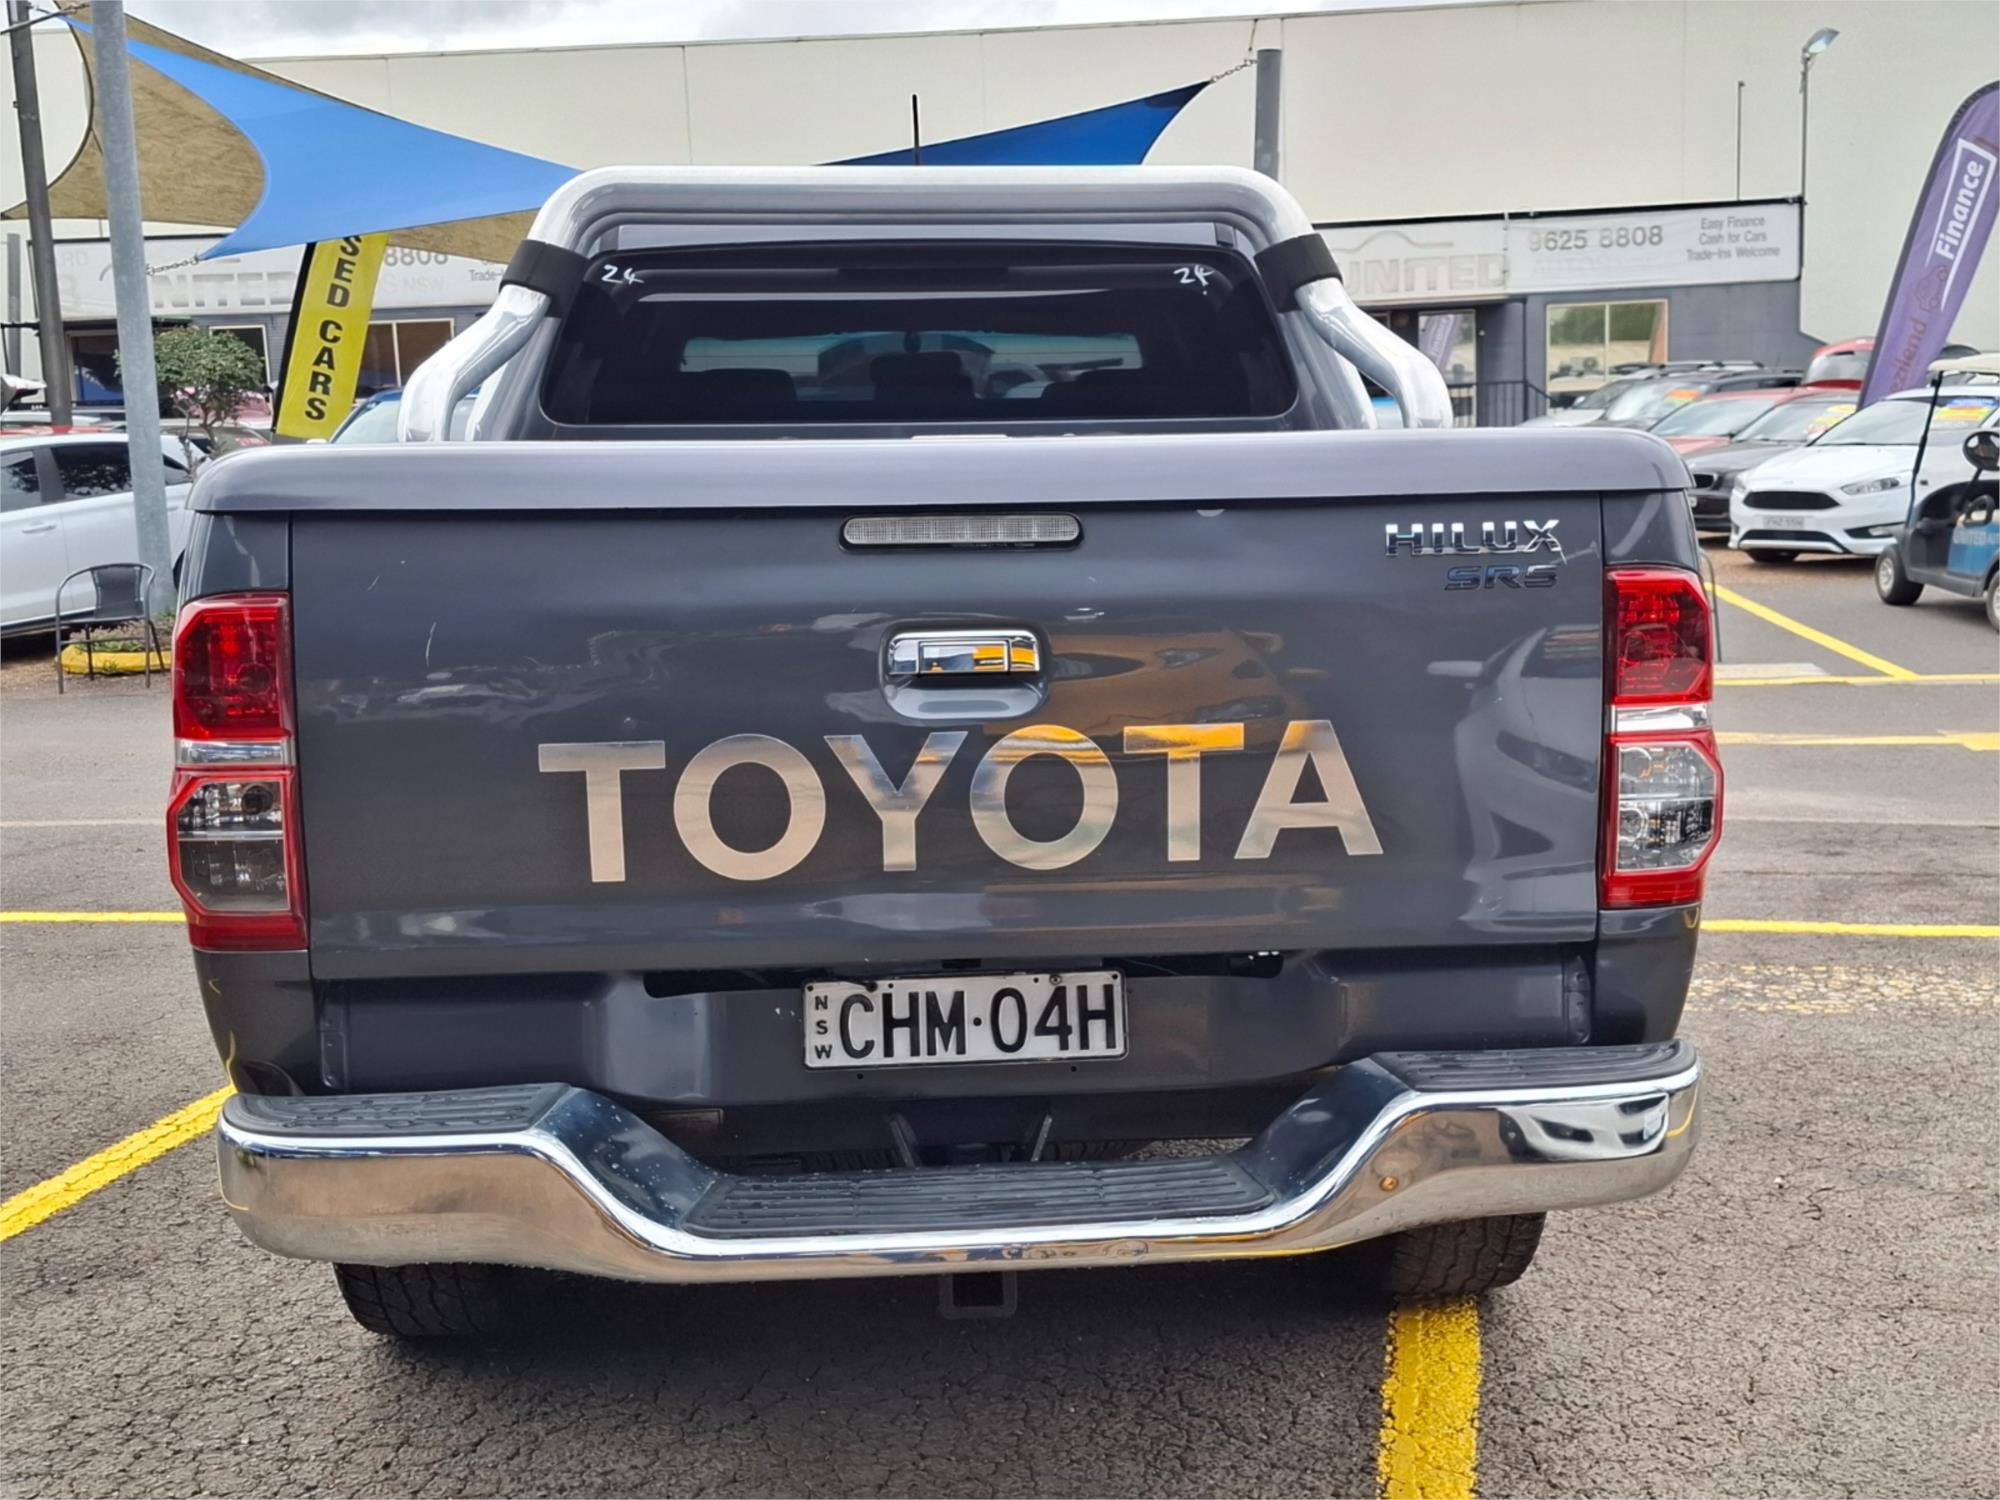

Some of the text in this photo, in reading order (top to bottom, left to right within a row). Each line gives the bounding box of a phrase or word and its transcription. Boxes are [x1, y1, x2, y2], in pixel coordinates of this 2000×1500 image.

[1700, 216, 1766, 231] Easy Finance
[1935, 160, 1984, 260] Finance
[1529, 225, 1663, 252] 9625 8808
[1698, 230, 1768, 245] Cash for Cars
[1735, 246, 1781, 258] Welcome
[151, 271, 297, 309] NITED
[601, 264, 645, 285] 24
[305, 235, 362, 421] SED CARS
[1385, 519, 1567, 562] HILUX
[538, 719, 1384, 883] TOYOTA
